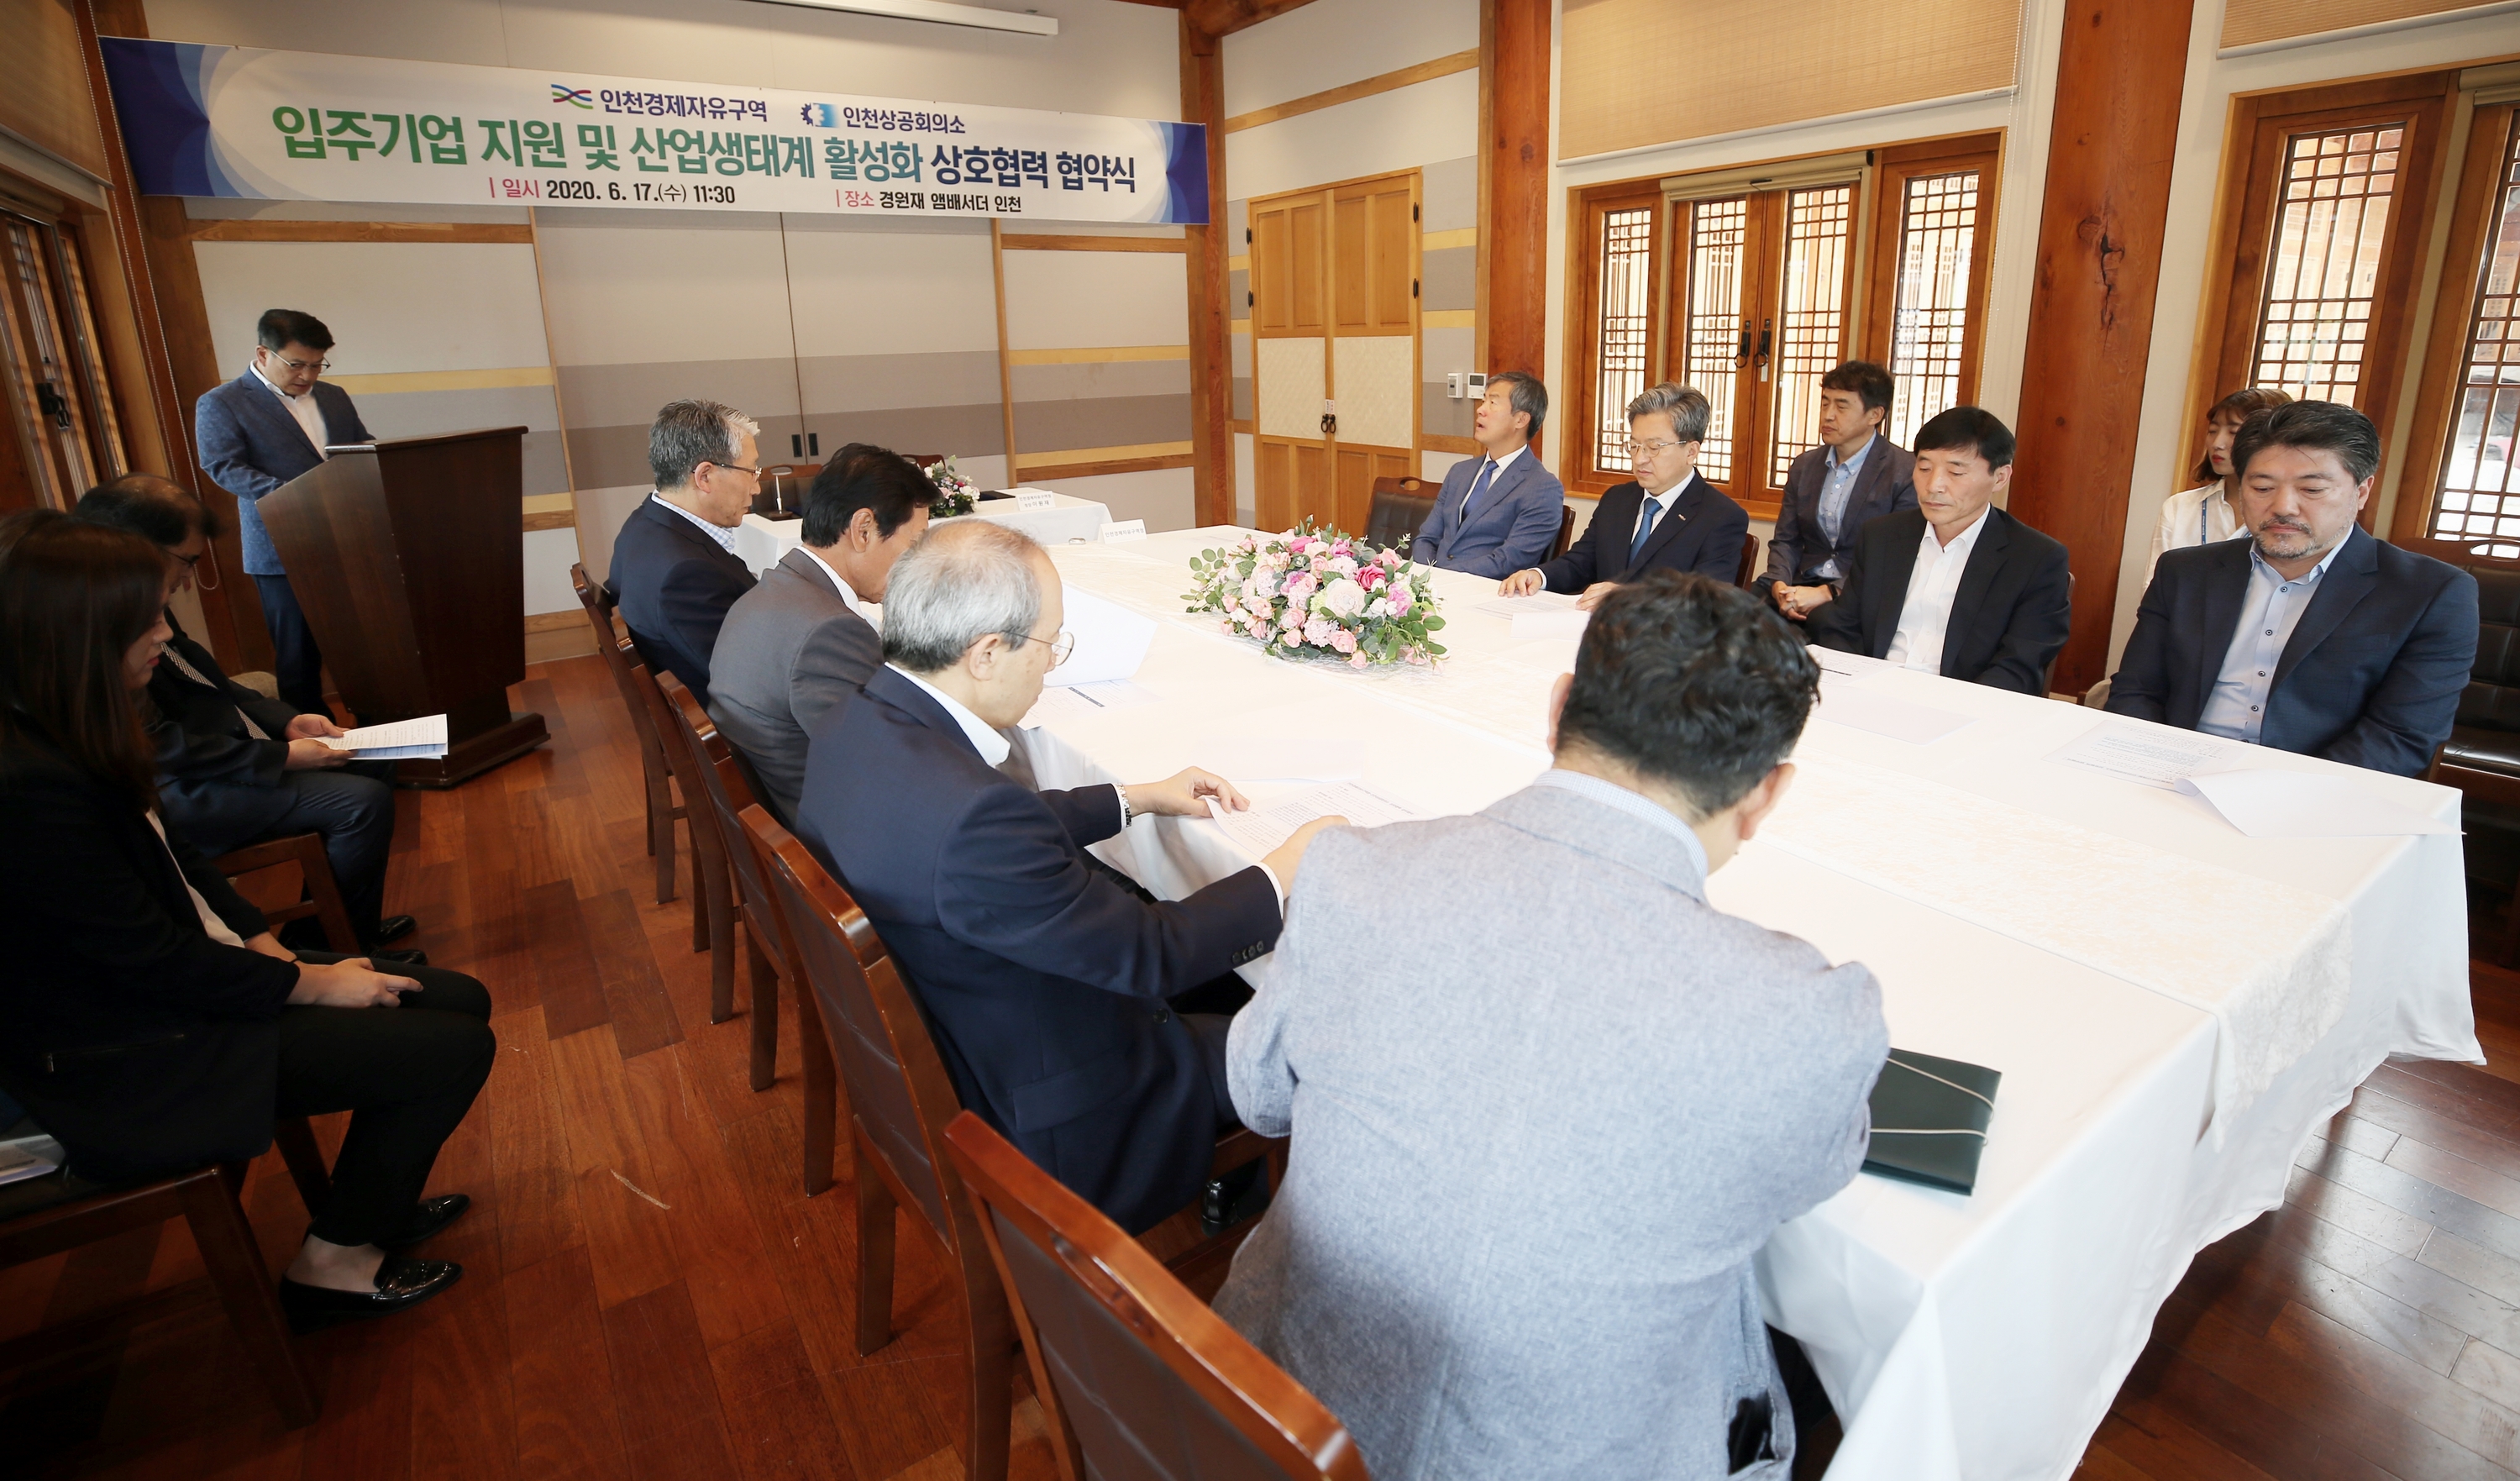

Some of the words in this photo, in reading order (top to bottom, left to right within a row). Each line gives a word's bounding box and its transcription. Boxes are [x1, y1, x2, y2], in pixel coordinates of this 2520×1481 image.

[600, 89, 768, 122] 인천경제자유구역
[843, 106, 966, 134] 인천상공회의소
[271, 105, 468, 165] 입주기업
[477, 118, 568, 169] 지원
[576, 123, 621, 171] 및
[629, 127, 815, 178] 산업생태계
[823, 136, 923, 183] 활성화
[931, 144, 1049, 190] 상호협력
[1055, 150, 1137, 194] 협약식
[501, 178, 540, 198] 일시
[546, 179, 601, 201] 2020.
[608, 181, 627, 201] 6.
[633, 182, 687, 203] 17.(수)
[693, 184, 736, 204] 11:30
[844, 189, 874, 208] 장소
[879, 191, 925, 210] 경원재
[930, 192, 989, 213] 앰배서더
[994, 195, 1022, 213] 인천
